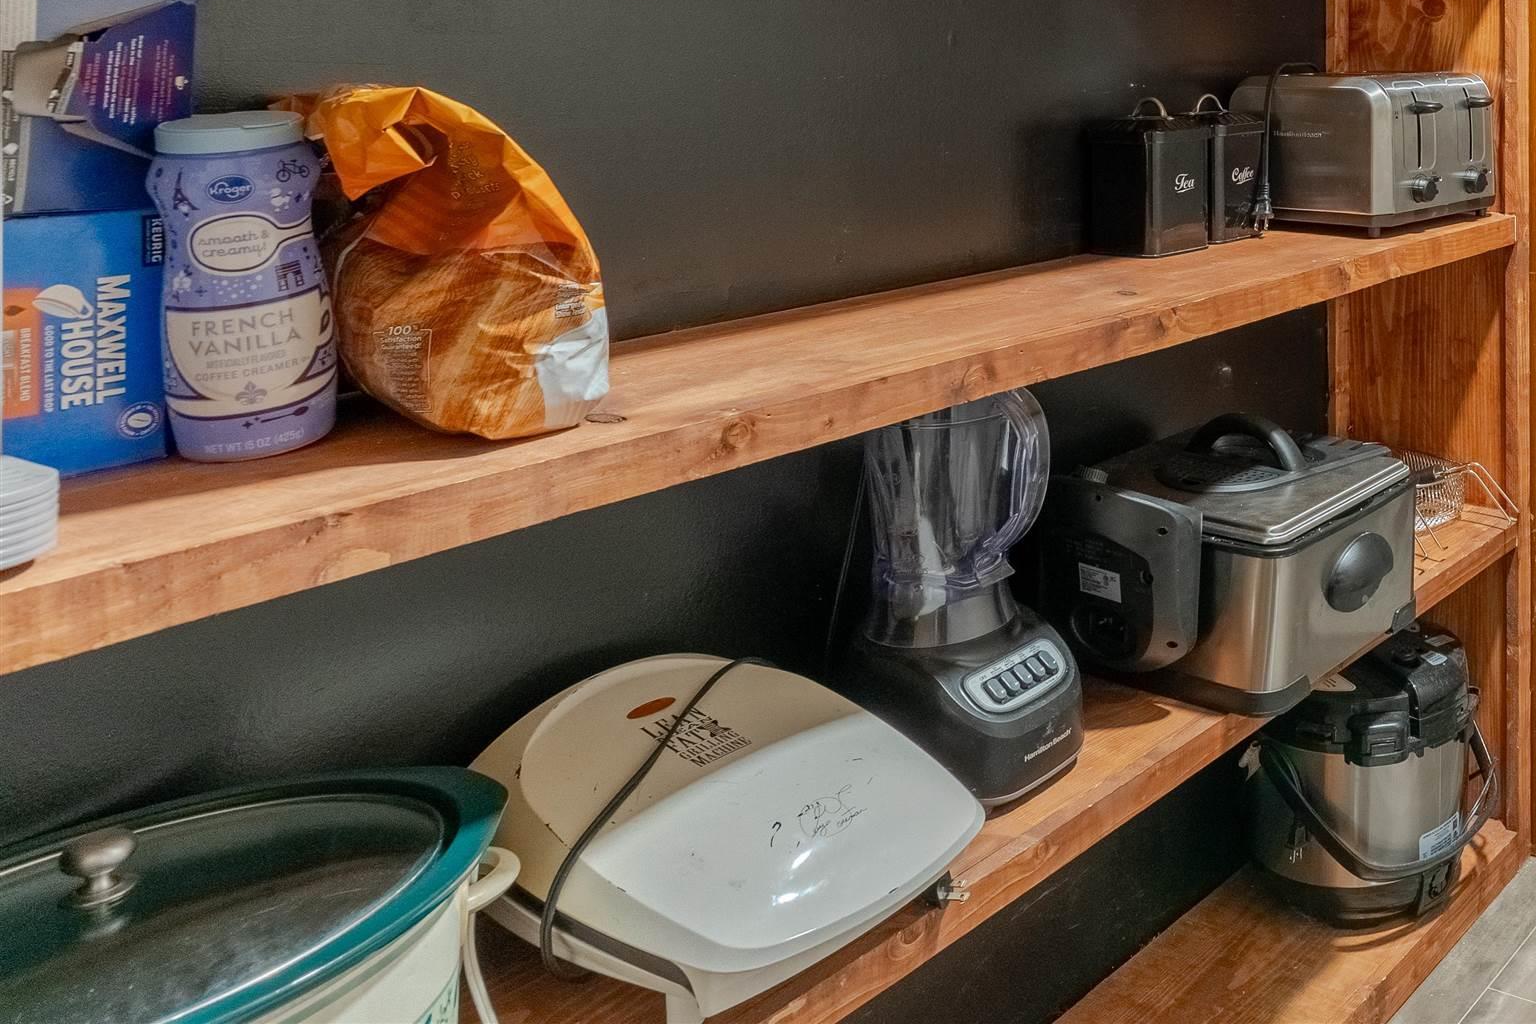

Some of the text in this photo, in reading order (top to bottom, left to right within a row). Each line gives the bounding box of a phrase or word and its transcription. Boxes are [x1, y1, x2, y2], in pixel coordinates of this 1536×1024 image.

[1174, 173, 1196, 192] Tea
[1231, 166, 1255, 184] Coffee
[209, 182, 252, 200] Kroger
[152, 217, 163, 264] KEURIG
[198, 229, 261, 247] smooth
[191, 307, 295, 338] FRENCH
[96, 273, 131, 405] MAXWELL
[187, 326, 303, 357] VANILLA
[19, 327, 32, 402] BREAKFAST BLEND
[60, 319, 95, 411] HOUSE
[194, 358, 299, 383] COFFEE CREAMER
[679, 730, 741, 761] GRILLING
[689, 736, 752, 768] MACHINE
[1023, 727, 1073, 763] Hamilton Beach
